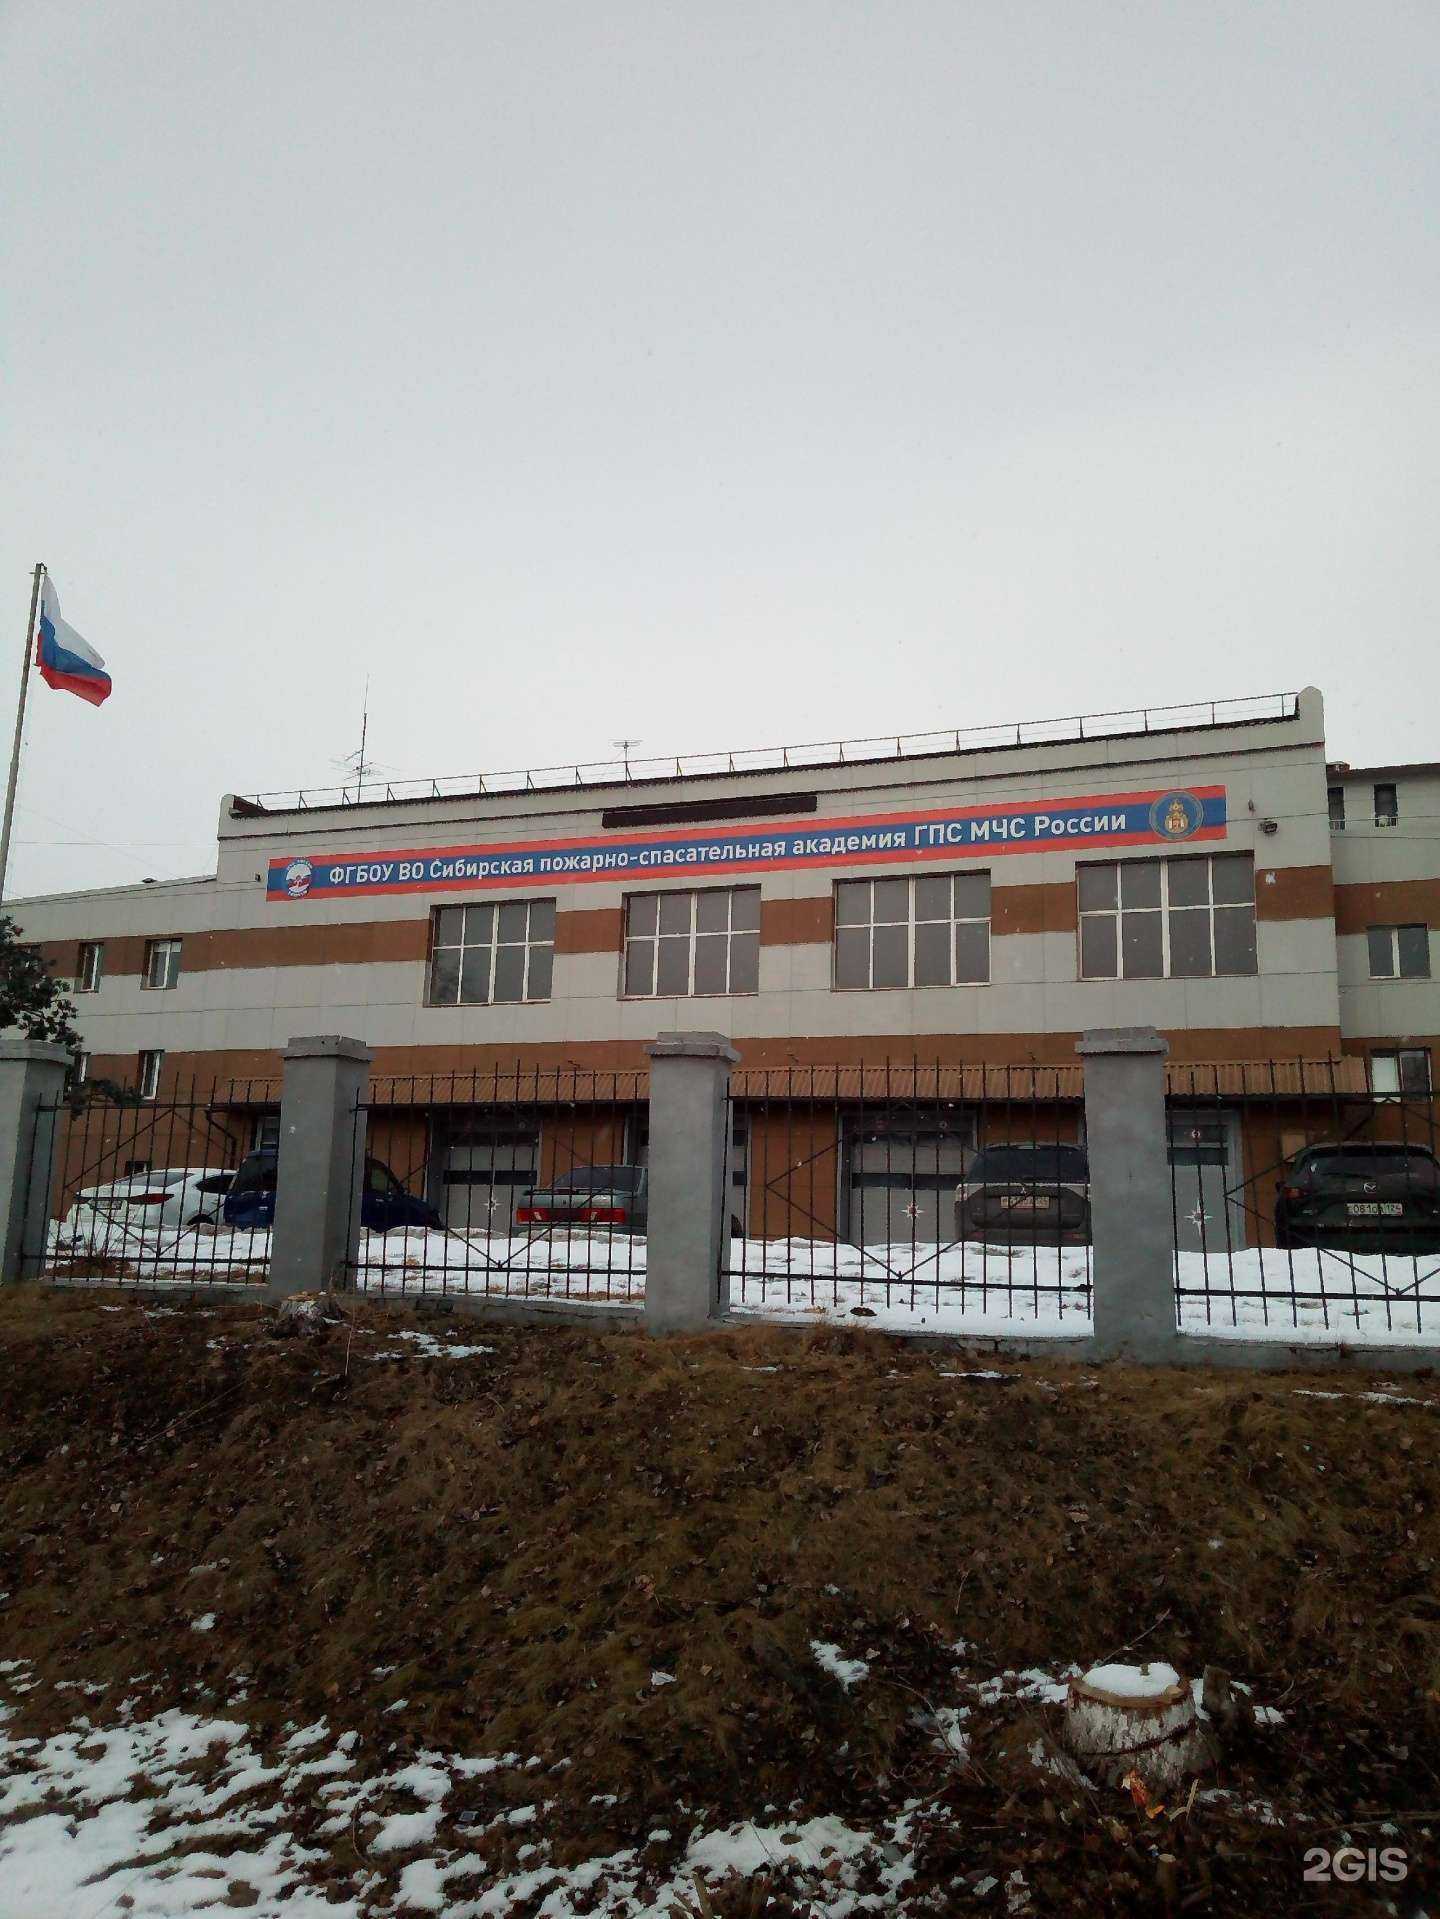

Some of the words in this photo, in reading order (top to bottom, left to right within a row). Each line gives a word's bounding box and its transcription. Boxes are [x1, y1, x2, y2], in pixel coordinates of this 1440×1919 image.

[329, 864, 393, 884] ФГБОУ
[399, 862, 423, 881] ВО
[430, 859, 533, 879] Сибирская
[540, 840, 785, 872] пожарно-спасательная
[793, 832, 905, 855] академия
[914, 823, 962, 845] ГПС
[970, 817, 1025, 841] МЧС
[1034, 814, 1126, 836] России
